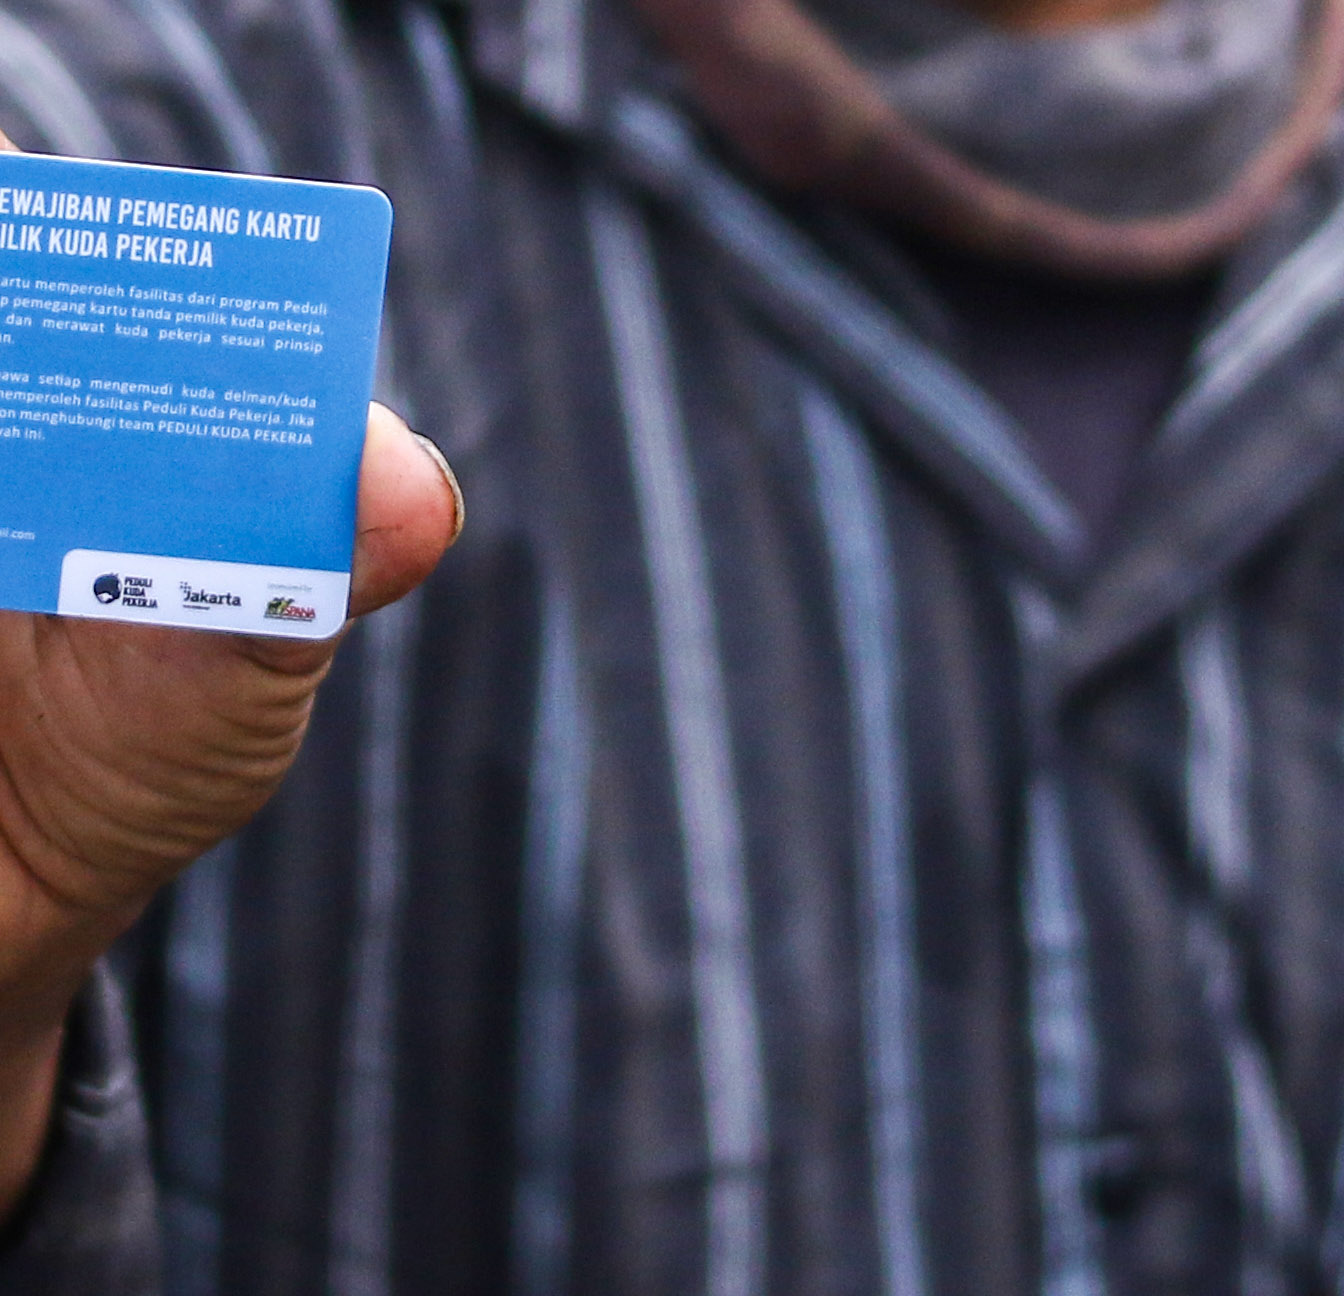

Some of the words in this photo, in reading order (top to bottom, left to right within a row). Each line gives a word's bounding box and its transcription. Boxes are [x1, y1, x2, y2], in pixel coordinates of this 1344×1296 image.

[118, 198, 240, 235] PEMEGANG
[246, 210, 321, 242] KARTU
[48, 228, 108, 258] KUDA
[116, 234, 213, 267] PEKERJA
[35, 280, 124, 297] memperoleh
[129, 286, 183, 303] fasilitas
[187, 292, 215, 305] dari
[219, 297, 279, 312] program
[284, 300, 328, 316] Peduli
[4, 312, 32, 327] dan
[42, 318, 105, 334] merawat
[115, 322, 148, 338] kuda
[158, 328, 211, 344] pekerja
[221, 334, 265, 347] sesuai
[274, 338, 323, 355] prinsip
[12, 296, 86, 315] pemegang
[89, 301, 128, 317] kartu
[130, 306, 172, 321] tanda
[175, 312, 228, 326] pemilik
[231, 314, 264, 329] kuda
[267, 319, 324, 336] pekerja,
[39, 374, 81, 389] setiap
[90, 380, 173, 396] mengemudi
[181, 384, 215, 400] kuda
[224, 390, 316, 409] delman/kuda
[19, 410, 116, 430] menghubungi
[118, 418, 154, 431] team
[158, 420, 208, 437] PEDULI
[209, 425, 250, 440] KUDA
[254, 428, 313, 446] PEKERJA
[85, 394, 139, 412] fasilitas
[142, 400, 187, 416] Peduli
[190, 405, 225, 419] Kuda
[229, 408, 284, 426] Pekerja.
[288, 413, 315, 428] Jika
[24, 428, 45, 440] ini.
[123, 586, 146, 598] KUDA
[124, 576, 153, 588] PEDULI
[183, 589, 242, 607] Jakarta
[121, 596, 159, 609] PEKERJA
